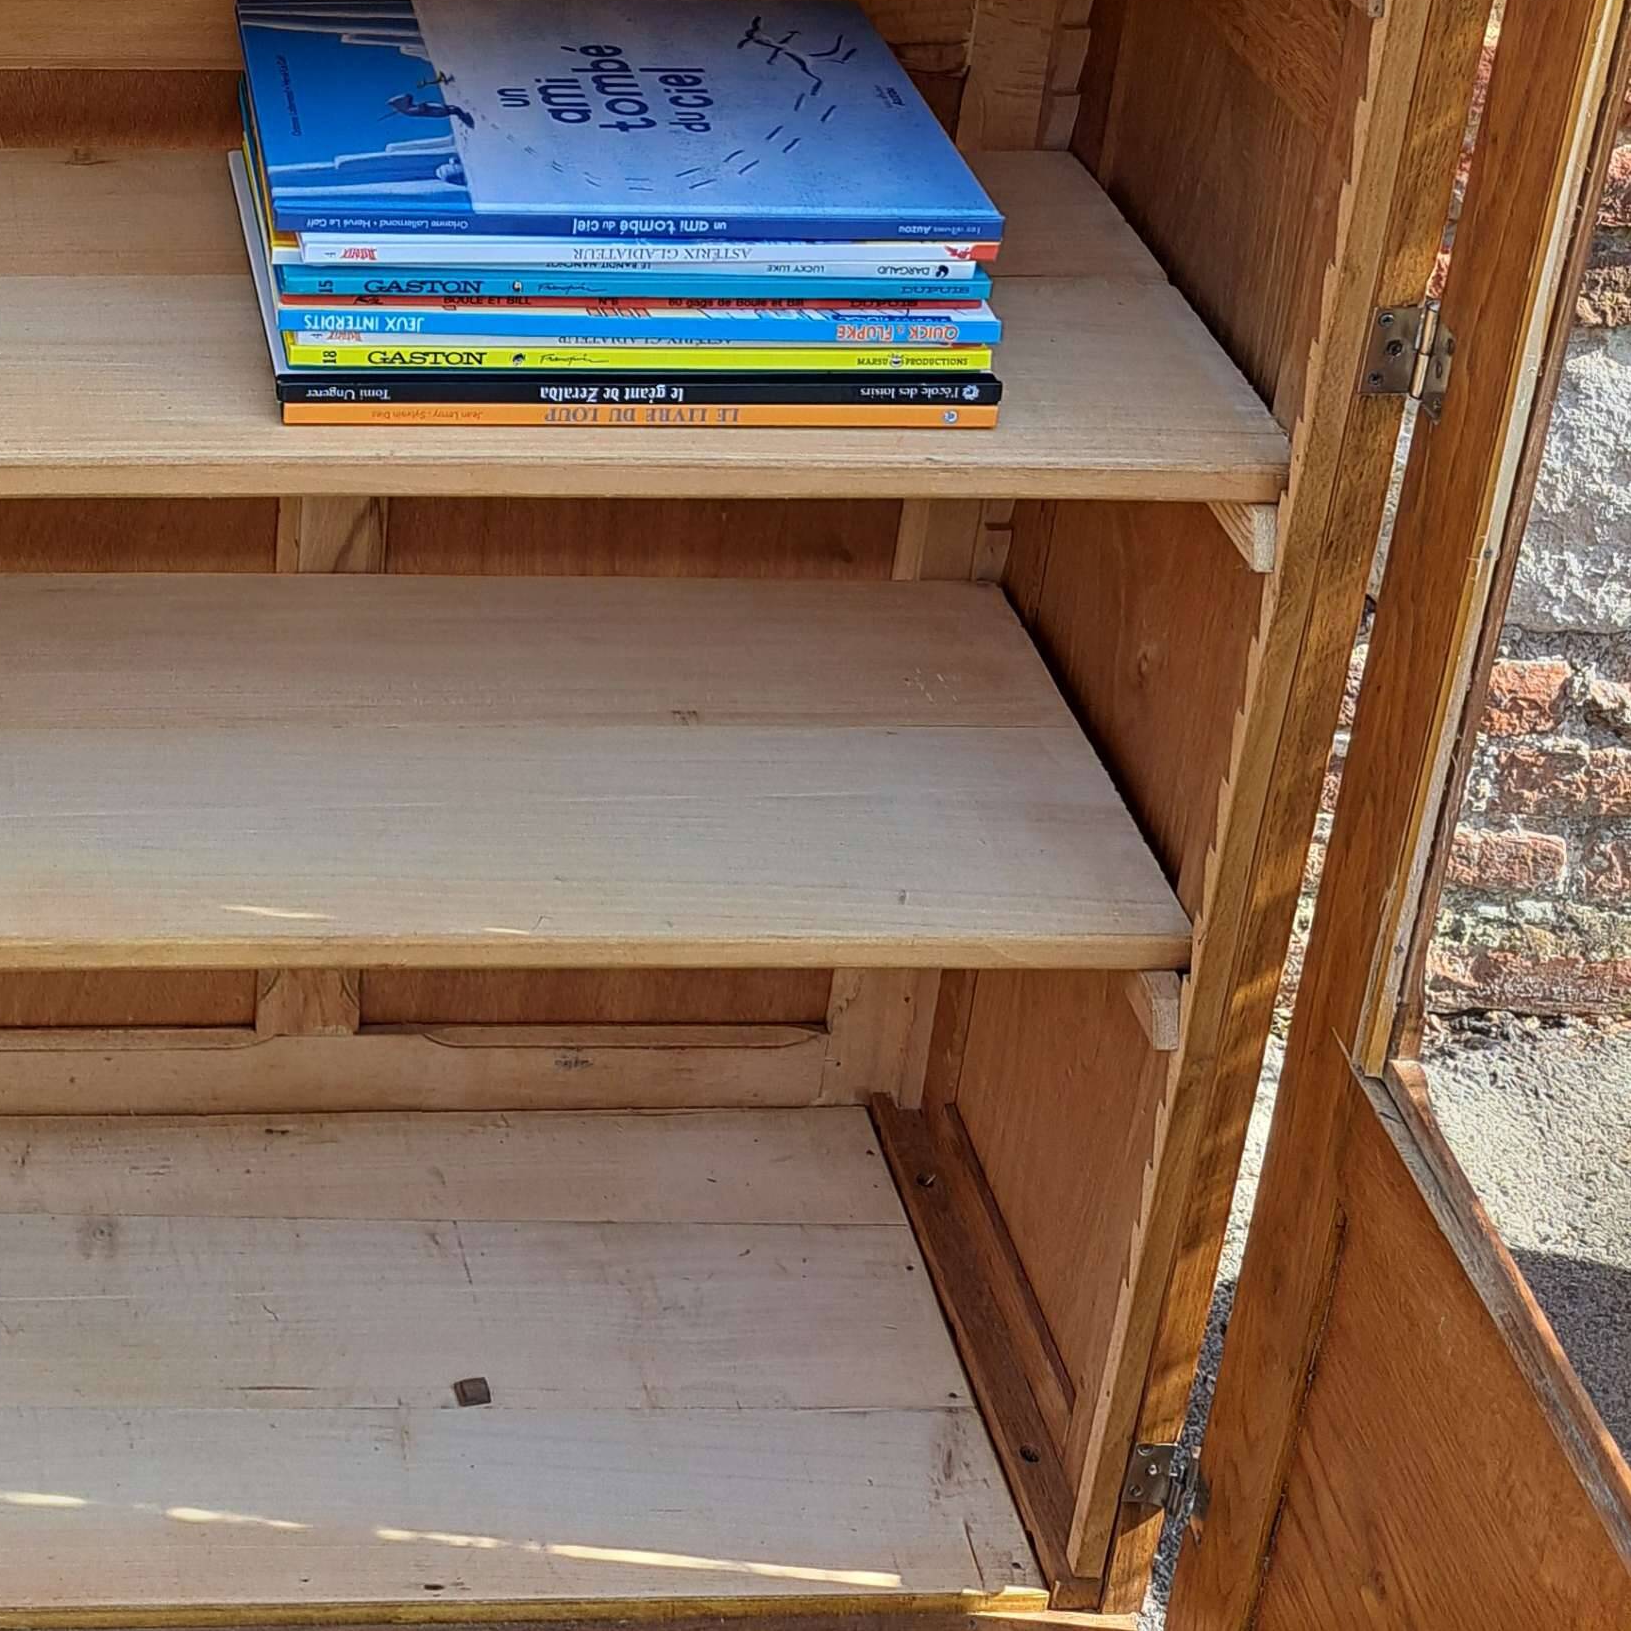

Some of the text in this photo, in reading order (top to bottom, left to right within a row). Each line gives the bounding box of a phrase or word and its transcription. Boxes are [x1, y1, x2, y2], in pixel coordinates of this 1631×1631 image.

[560, 44, 657, 133] tombé
[496, 88, 531, 108] un
[534, 77, 593, 124] ami
[638, 67, 714, 133] du ciel
[572, 218, 727, 236] un ami tombé du ciel
[572, 247, 753, 263] ASTÉRIX GLADIATEUR
[766, 264, 931, 276] DARGAUD LUCKY LUKE
[303, 314, 425, 332] JEUX INTERDITS
[836, 324, 893, 342] FLUPKE
[908, 325, 959, 342] QUICK
[322, 350, 338, 364] 18
[367, 351, 488, 365] GASTON
[856, 357, 968, 366] MARSU PRODUCTIONS
[305, 386, 391, 400] Tomi Ungerer
[539, 384, 684, 405] le géant de Zeralda
[859, 384, 959, 400] l'école des loisirs
[544, 406, 740, 423] LE LIVRE DU LOUP
